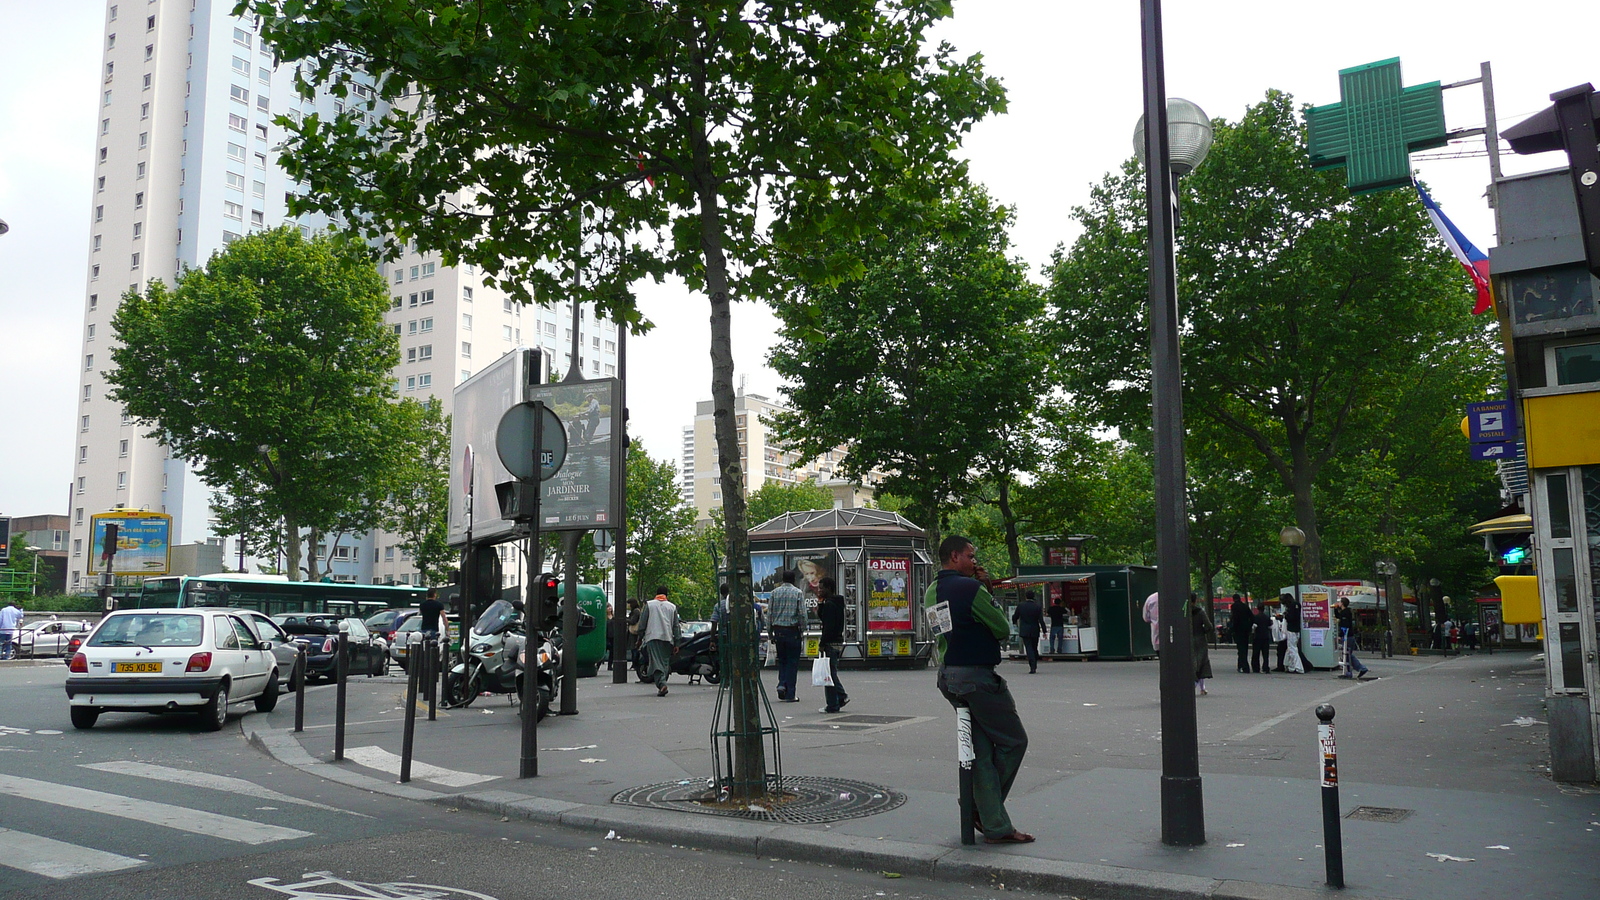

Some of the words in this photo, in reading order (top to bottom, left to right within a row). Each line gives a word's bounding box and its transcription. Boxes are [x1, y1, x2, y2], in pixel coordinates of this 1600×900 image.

[541, 452, 552, 463] DF
[553, 469, 582, 480] Dialogue
[547, 484, 590, 497] JARDINIER
[867, 559, 879, 569] Le
[880, 559, 906, 570] Point
[805, 596, 818, 607] RÈS
[120, 663, 133, 671] 735
[148, 663, 157, 671] 94
